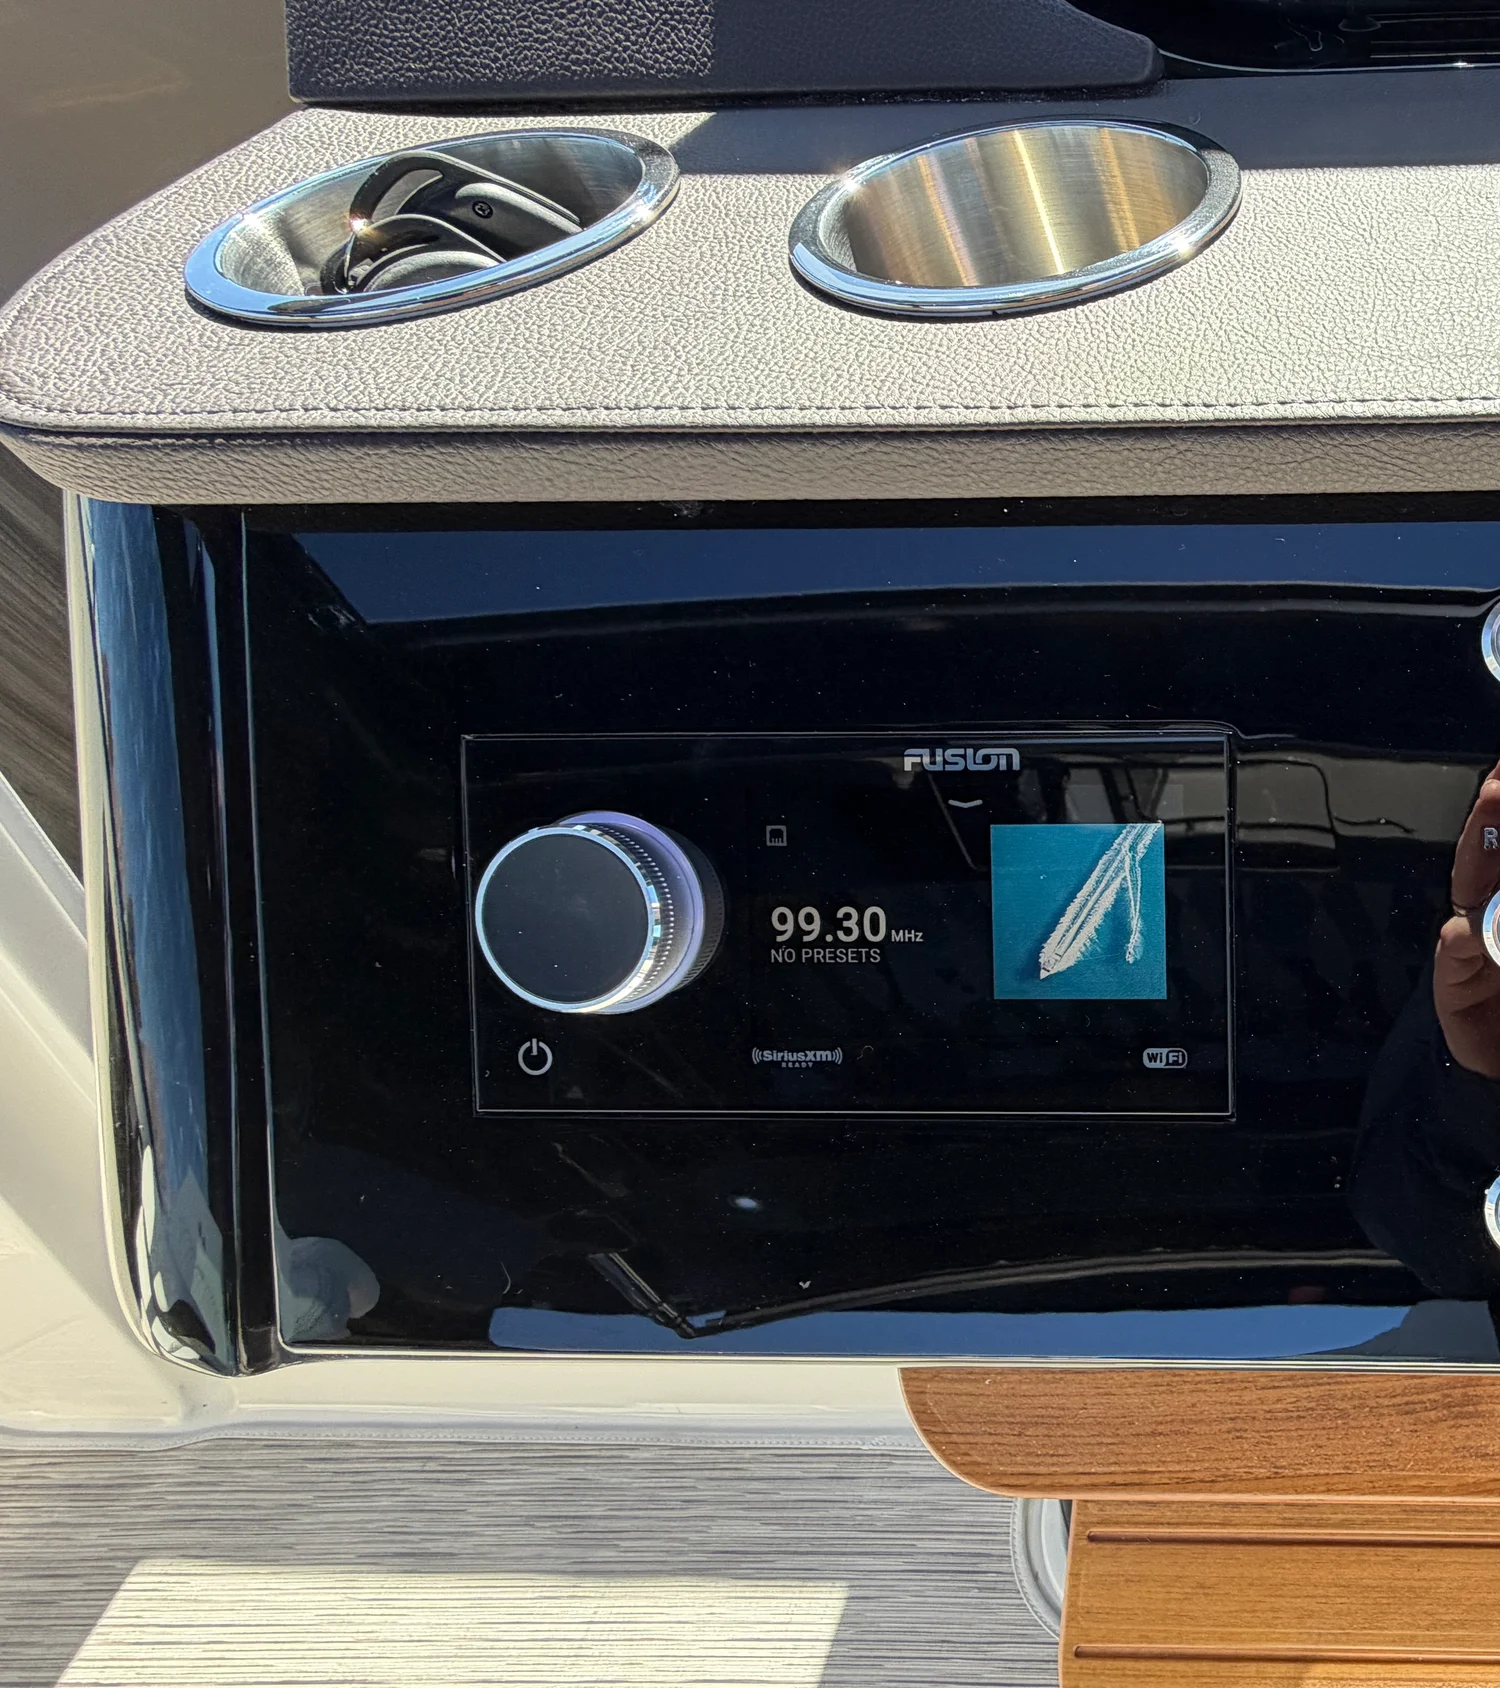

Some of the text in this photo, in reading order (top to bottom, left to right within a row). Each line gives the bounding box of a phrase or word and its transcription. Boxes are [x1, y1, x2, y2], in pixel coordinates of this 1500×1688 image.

[903, 747, 1021, 771] FUSION
[771, 906, 924, 942] 99.30 MHz
[770, 949, 881, 963] NO PRESETS
